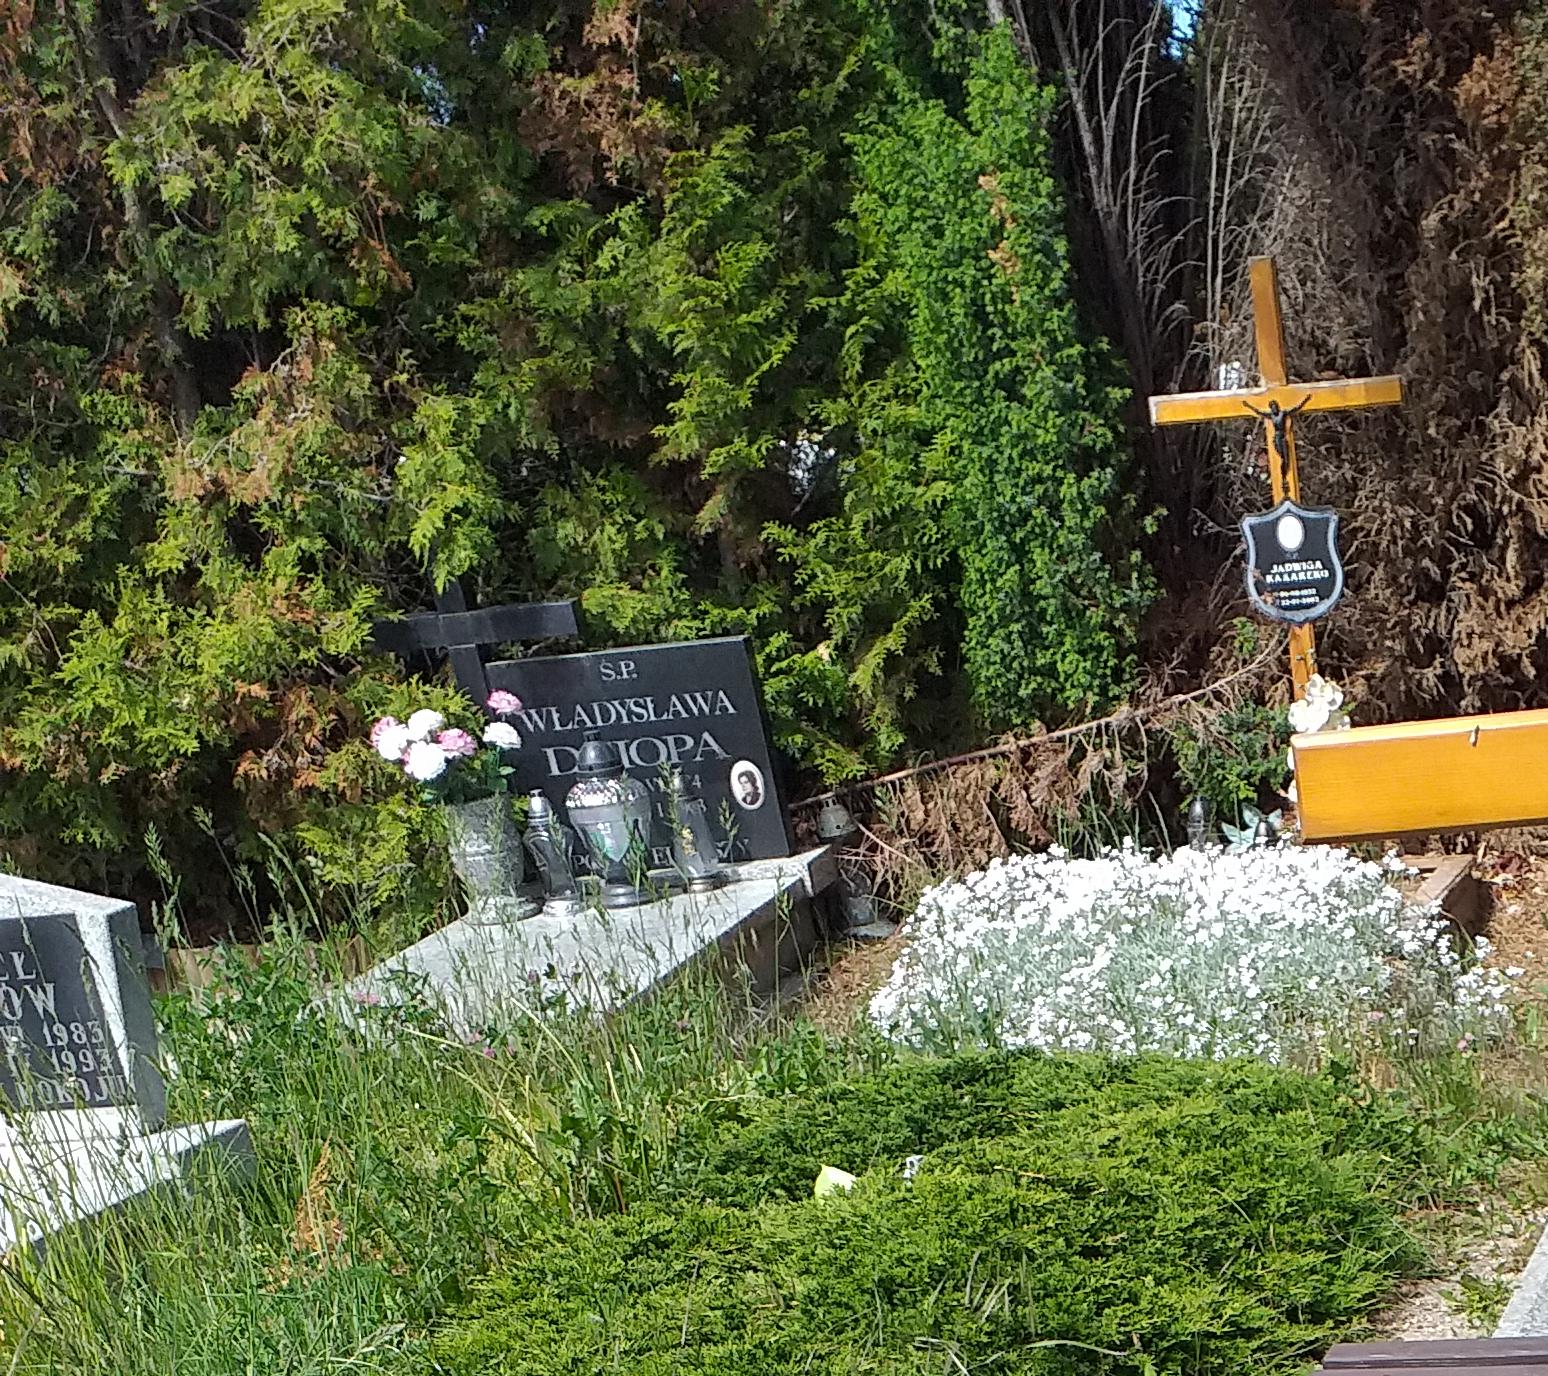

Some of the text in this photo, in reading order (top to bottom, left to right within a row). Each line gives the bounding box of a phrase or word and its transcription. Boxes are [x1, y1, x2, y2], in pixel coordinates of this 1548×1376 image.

[1270, 560, 1323, 574] JADWIGA
[520, 689, 738, 734] WŁADYSŁAWA
[541, 730, 731, 777] DIOPA
